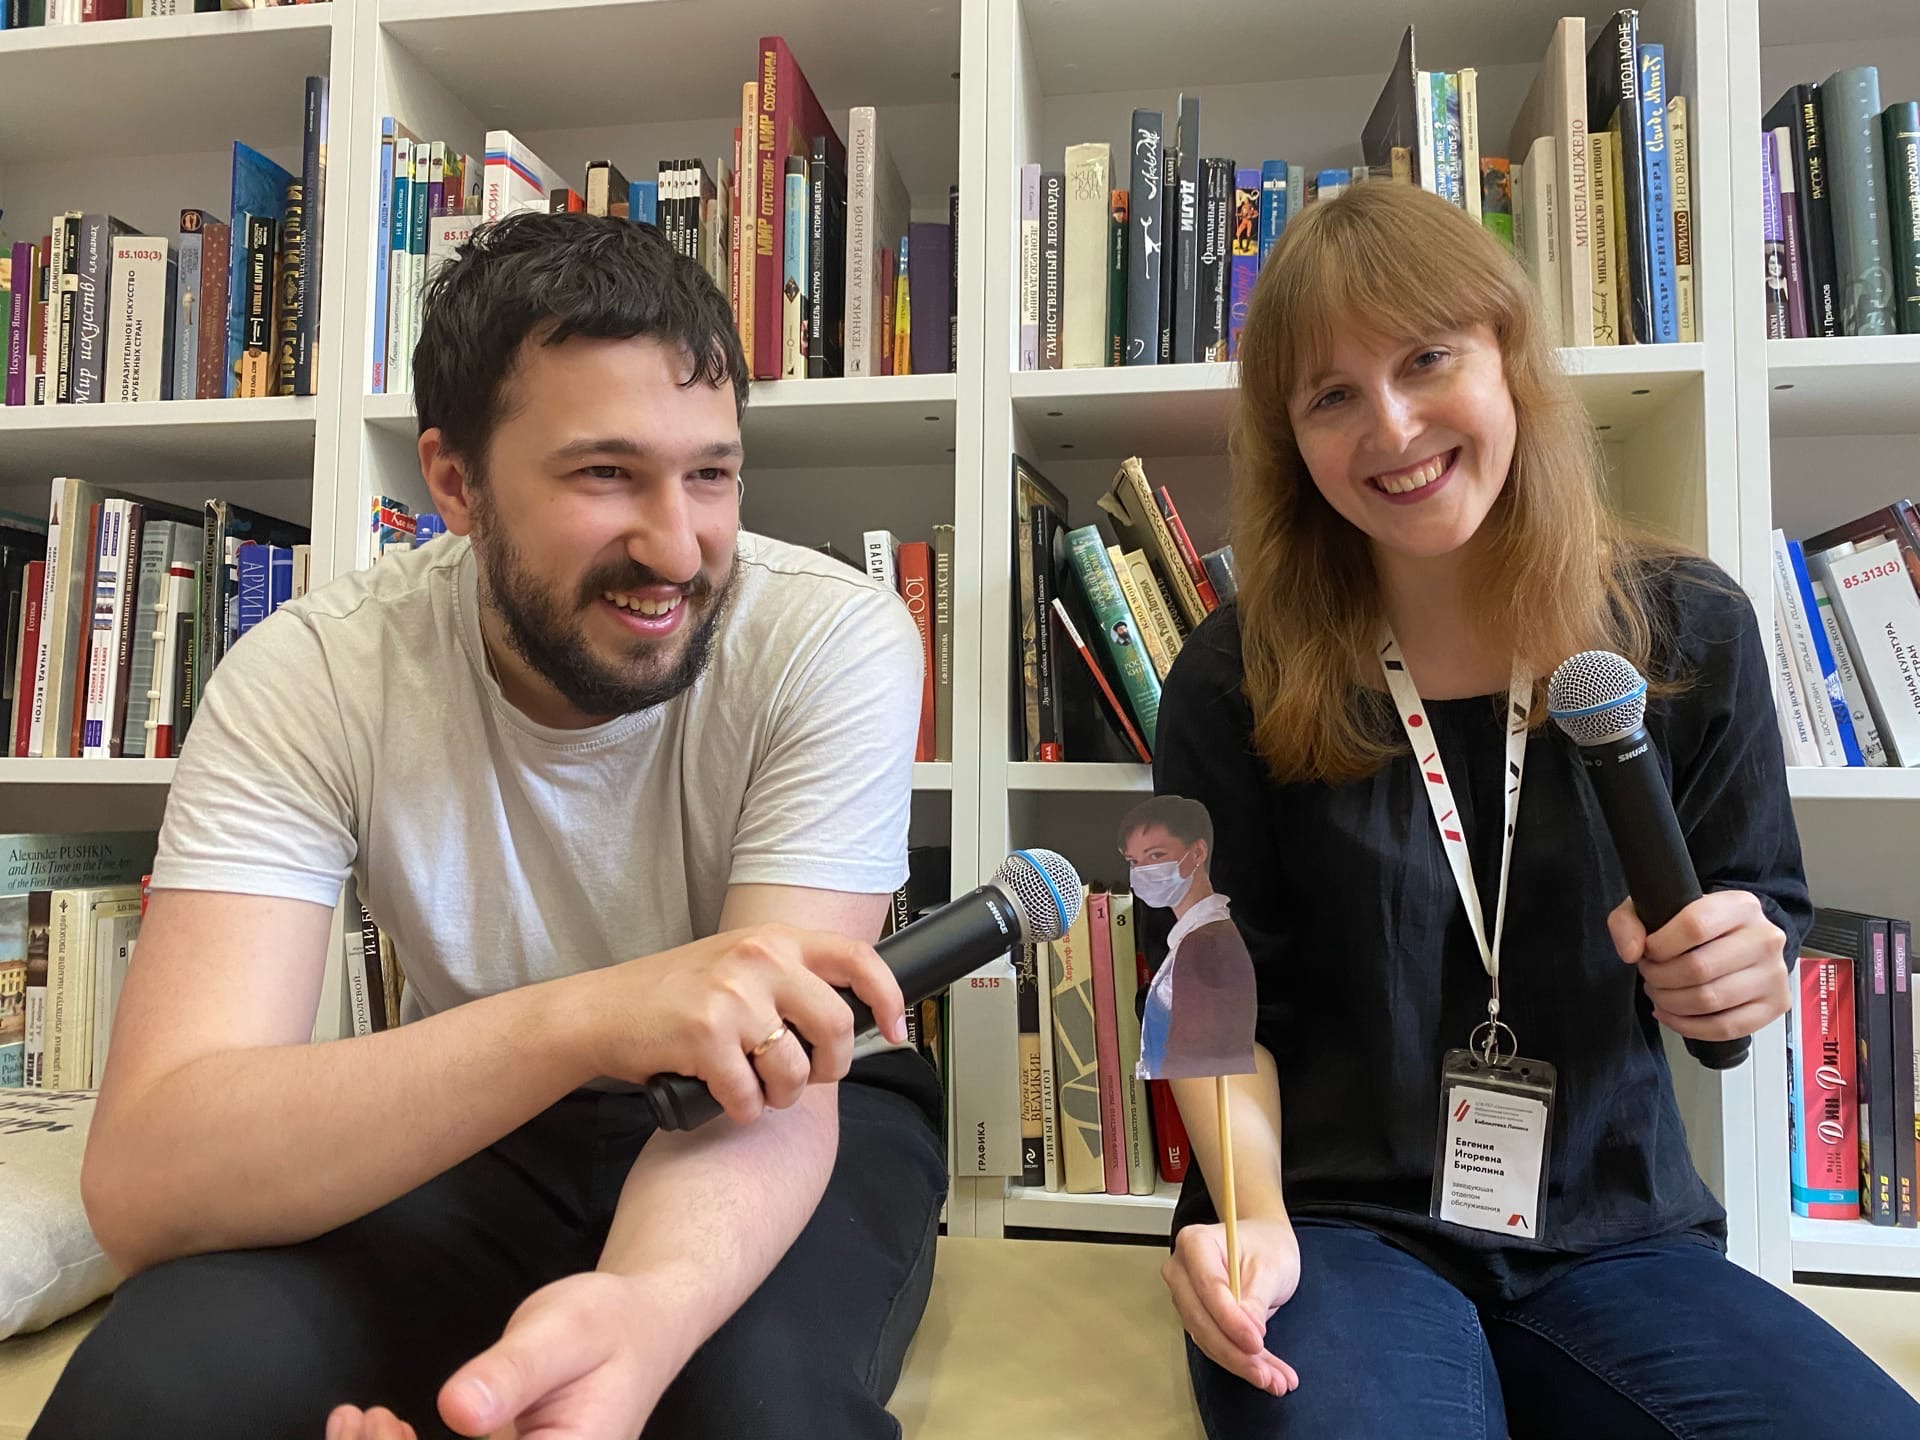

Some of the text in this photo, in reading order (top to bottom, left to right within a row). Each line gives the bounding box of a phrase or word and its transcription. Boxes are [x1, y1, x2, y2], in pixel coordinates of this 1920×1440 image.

[1618, 22, 1634, 100] КЛОД МОНЕ
[757, 51, 777, 256] МИР ОТСТОЯЛИ МИР СОХРАНИМ
[1436, 140, 1445, 162] МОНЕ
[1674, 138, 1685, 174] ВРЕМЯ
[1571, 119, 1589, 248] МИКЕЛАНДЖЕЛО
[1676, 176, 1686, 195] ЕГО
[396, 188, 405, 219] Осипова
[417, 193, 425, 224] Осипова
[1180, 179, 1195, 231] ДАЛИ
[852, 128, 865, 349] ТЕХНИКА АКВАРЕЛЬНОЙ ЖИВОПИСИ
[1201, 200, 1217, 265] Фамильные
[1217, 201, 1226, 257] ценности
[1677, 212, 1690, 264] МУРИЛЬО
[118, 249, 162, 262] 85.103(3)
[812, 181, 822, 338] МИШЕЛЬ ПАСТУРО ИСТОРИЯ ЦВЕТА
[1029, 225, 1039, 274] ЛЕОНАРДО
[52, 252, 61, 295] ДОВМОНТОВ
[1046, 178, 1060, 359] ТАИНСТВЕННЫЙ ЛЕОНАРДО
[1823, 284, 1834, 327] Привалов
[9, 293, 21, 375] Искусство Японии
[121, 270, 136, 404] ЗОБРАЗИТЕЛЬНОЕ ИСКУССТВО
[132, 319, 143, 403] АРУБЕЖНЫХ СТРАН
[374, 362, 382, 388] burda
[1843, 559, 1901, 589] 85.313(3)
[905, 576, 925, 614] 100
[26, 601, 36, 632] Готика
[1826, 617, 1852, 682] ЧАЙКОВСКОГО
[1884, 620, 1920, 715] ЛЬНАЯ КУЛЬТУРА
[34, 643, 48, 723] РИЧАРД ВЕСТОН
[1617, 743, 1649, 763] SHURE
[8, 865, 27, 876] and
[31, 863, 46, 875] His
[49, 861, 70, 874] Time
[82, 859, 97, 871] the
[9, 844, 112, 862] Alexander PUSHKIN
[8, 879, 16, 889] of
[17, 878, 29, 888] the
[30, 877, 46, 887] First
[986, 901, 1008, 934] SHURE
[1097, 908, 1105, 920] 1
[1116, 914, 1126, 927] 3
[1063, 946, 1073, 982] Херлуф
[1896, 945, 1905, 979] Шуберт
[971, 978, 1000, 989] 85.15
[1820, 1001, 1828, 1035] ТРАГЕДИЯ
[1030, 1052, 1042, 1122] ВЕЛИКИЕ
[1043, 1069, 1055, 1165] ЗРИМЫЙ ГЛАГОЛ
[977, 1120, 986, 1171] ГРАФИКА
[1454, 1149, 1502, 1164] Игоревна
[1455, 1137, 1495, 1151] Евгения
[1454, 1160, 1505, 1177] Бирюлина
